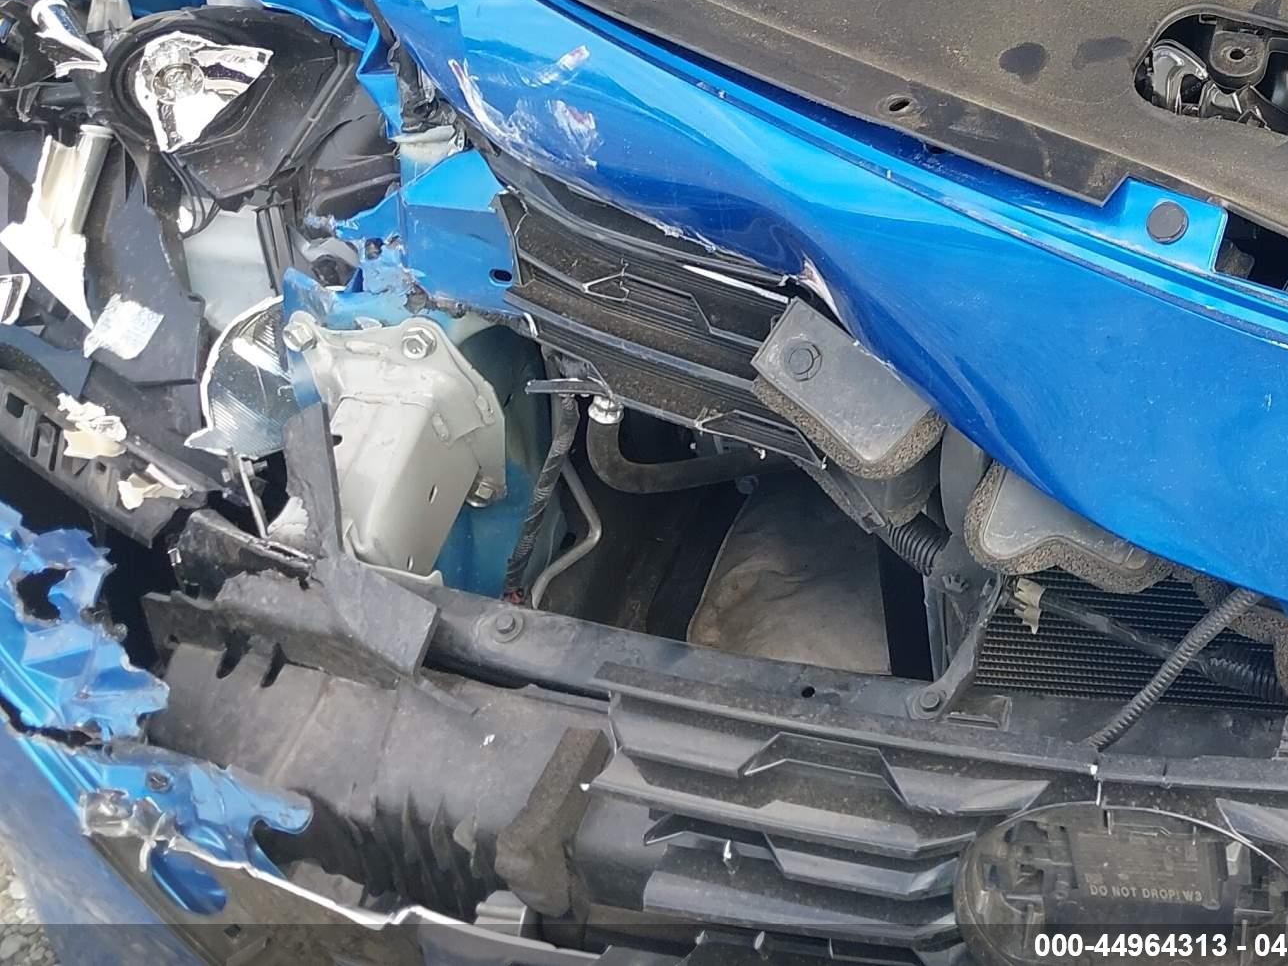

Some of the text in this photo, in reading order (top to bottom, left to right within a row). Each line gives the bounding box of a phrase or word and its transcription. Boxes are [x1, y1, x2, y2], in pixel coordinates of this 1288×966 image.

[1089, 884, 1108, 897] DO
[1112, 886, 1137, 898] NOT
[1142, 888, 1180, 900] DROP!
